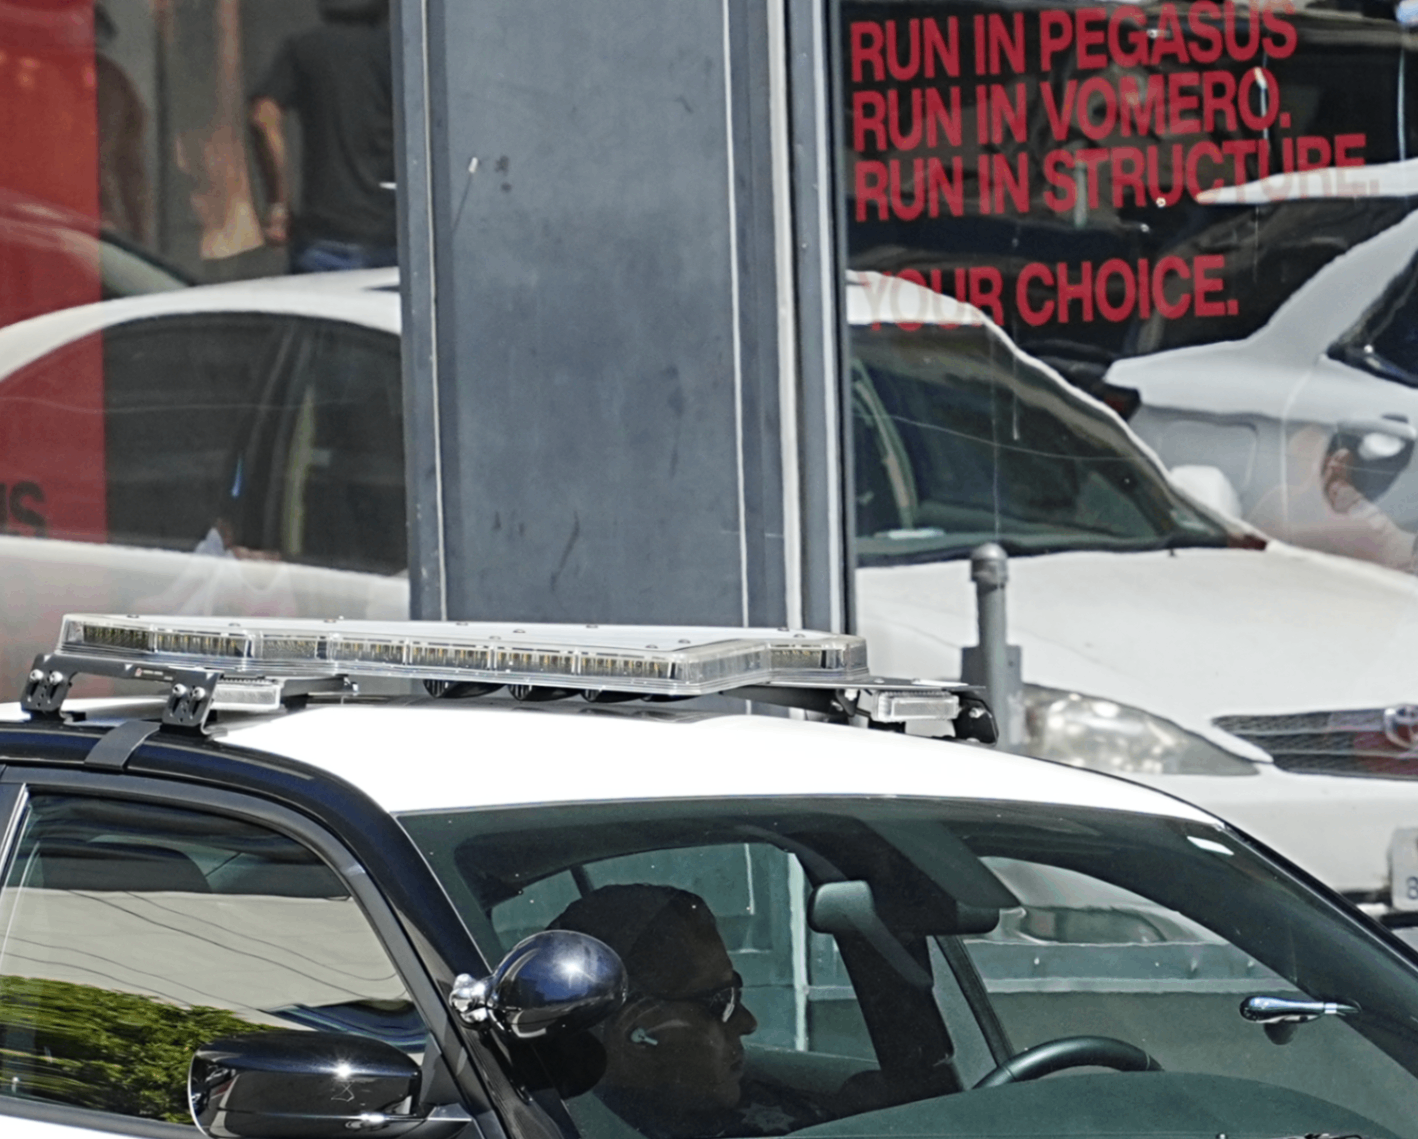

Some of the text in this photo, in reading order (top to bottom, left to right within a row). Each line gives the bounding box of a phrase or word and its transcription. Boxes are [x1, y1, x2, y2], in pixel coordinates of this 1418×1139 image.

[850, 0, 1298, 82] RUN IN PEGASUS
[853, 67, 1292, 152] RUN IN VOMERO.
[855, 134, 1379, 222] RUN IN STRUCTURE.
[857, 254, 1239, 332] YOUR CHOICE.
